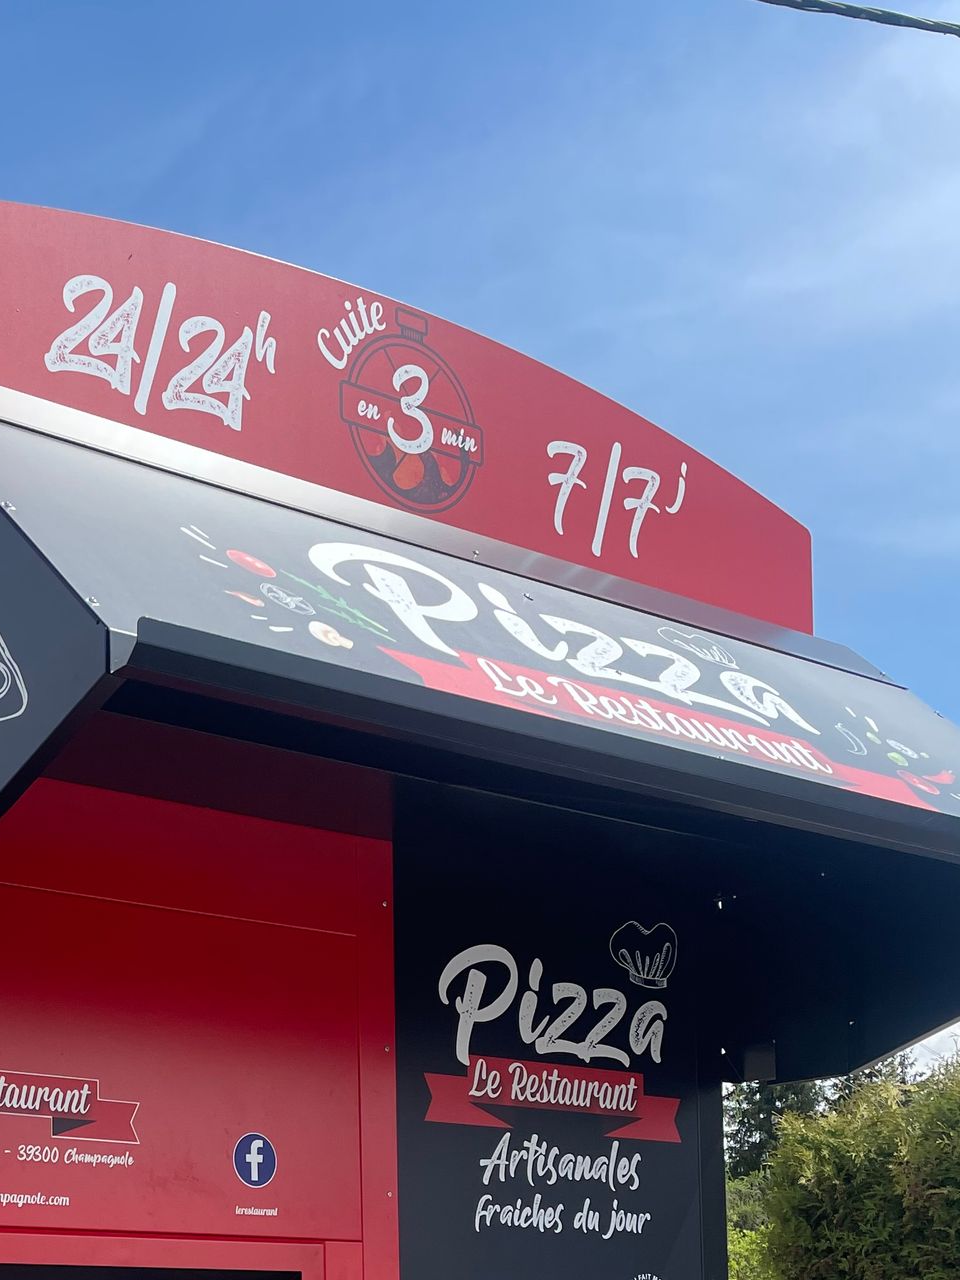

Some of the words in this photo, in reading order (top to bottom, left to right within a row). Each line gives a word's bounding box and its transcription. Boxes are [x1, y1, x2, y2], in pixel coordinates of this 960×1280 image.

[44, 274, 277, 431] 24/24h
[317, 297, 386, 370] Cuite
[356, 400, 381, 421] en
[386, 364, 434, 455] 3
[441, 426, 478, 455] min
[308, 541, 821, 735] Pizza
[475, 656, 557, 706] Le
[558, 676, 834, 776] Restaurant
[438, 943, 668, 1068] Pizza
[468, 1058, 503, 1098] Le
[508, 1062, 639, 1112] Restaurant
[16, 1144, 60, 1164] 39300
[63, 1147, 135, 1169] Champagnole
[479, 1131, 643, 1192] Artisanales
[573, 1197, 600, 1233] du
[601, 1198, 652, 1240] jour
